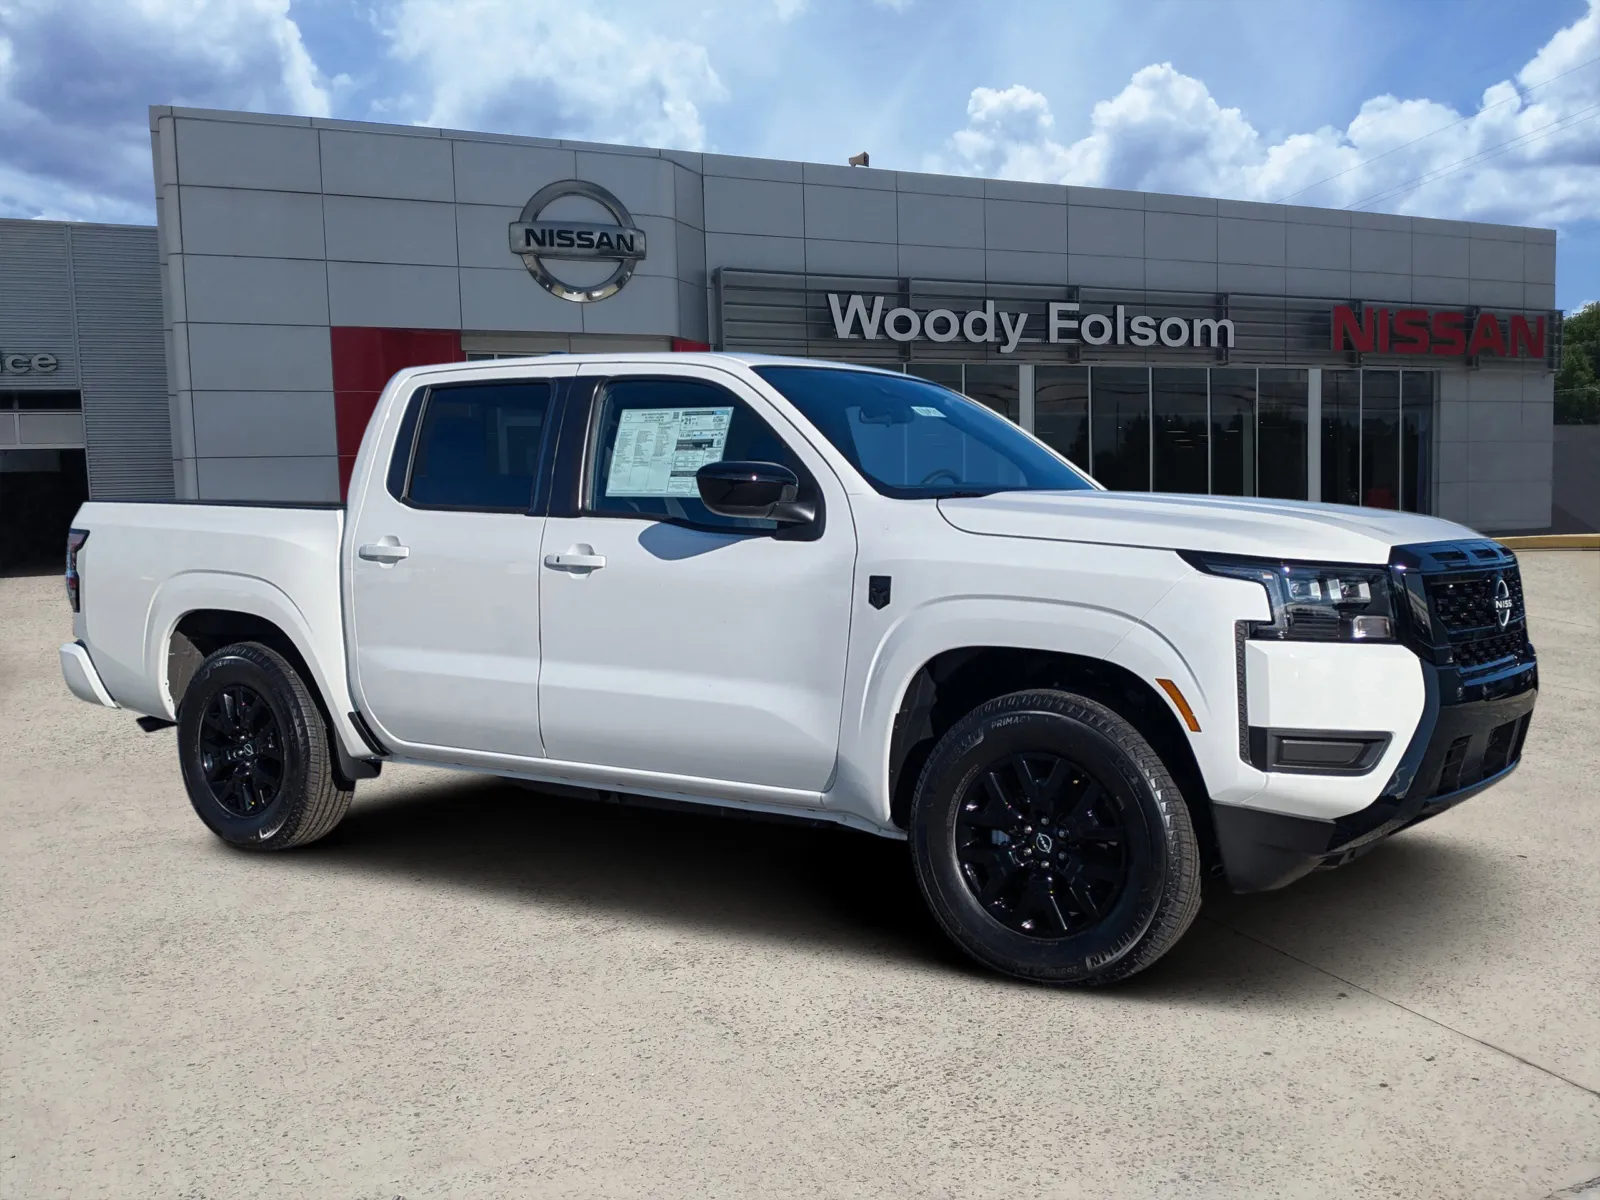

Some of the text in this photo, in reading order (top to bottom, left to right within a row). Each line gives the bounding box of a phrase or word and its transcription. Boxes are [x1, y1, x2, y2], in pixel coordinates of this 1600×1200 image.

[524, 228, 635, 253] NISSAN
[827, 293, 1236, 354] Woody Folsom
[1332, 304, 1545, 359] NISSAN
[0, 353, 58, 374] ce
[1495, 599, 1513, 609] NISS
